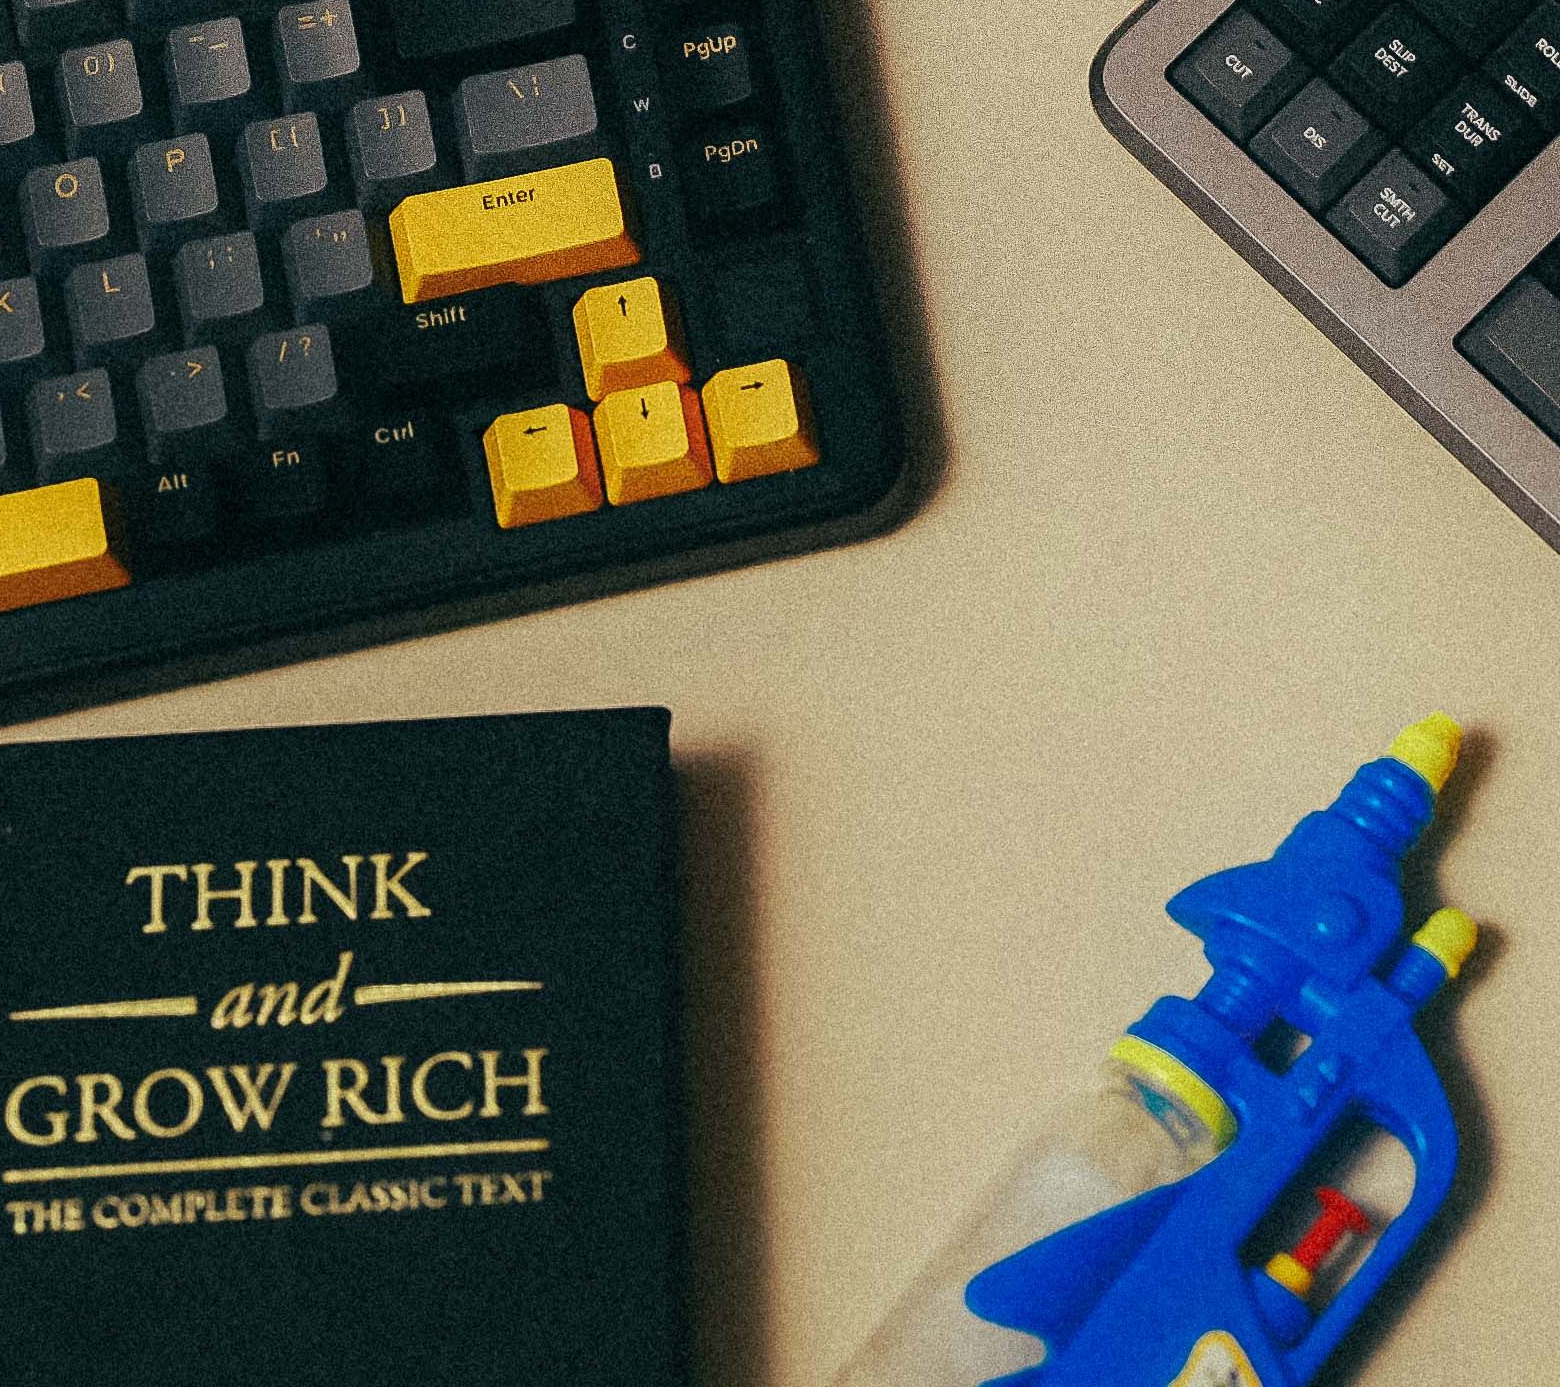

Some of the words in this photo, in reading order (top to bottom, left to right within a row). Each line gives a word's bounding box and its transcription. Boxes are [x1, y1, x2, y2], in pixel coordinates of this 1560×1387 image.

[682, 33, 738, 60] PgUp
[1386, 36, 1419, 67] SLIP
[1222, 51, 1254, 82] CUT
[1371, 45, 1410, 81] DEST
[1300, 124, 1329, 151] DIS
[1451, 118, 1485, 150] DUR
[1457, 100, 1504, 144] TRANS
[162, 146, 187, 172] P
[703, 137, 760, 164] PgDn
[53, 170, 81, 200] O
[480, 185, 537, 211] Enter
[1370, 201, 1401, 230] CUT
[1377, 184, 1419, 223] SMTH
[414, 303, 466, 329] Shift
[270, 449, 302, 466] Fn
[126, 851, 431, 935] THINK
[210, 952, 354, 1030] and
[4, 1062, 298, 1147] GROW
[322, 1048, 549, 1128] RICH
[5, 1197, 85, 1234] THE
[91, 1184, 293, 1230] COMPLETE
[301, 1174, 451, 1218] CLASSIC
[453, 1169, 552, 1207] TEXT
